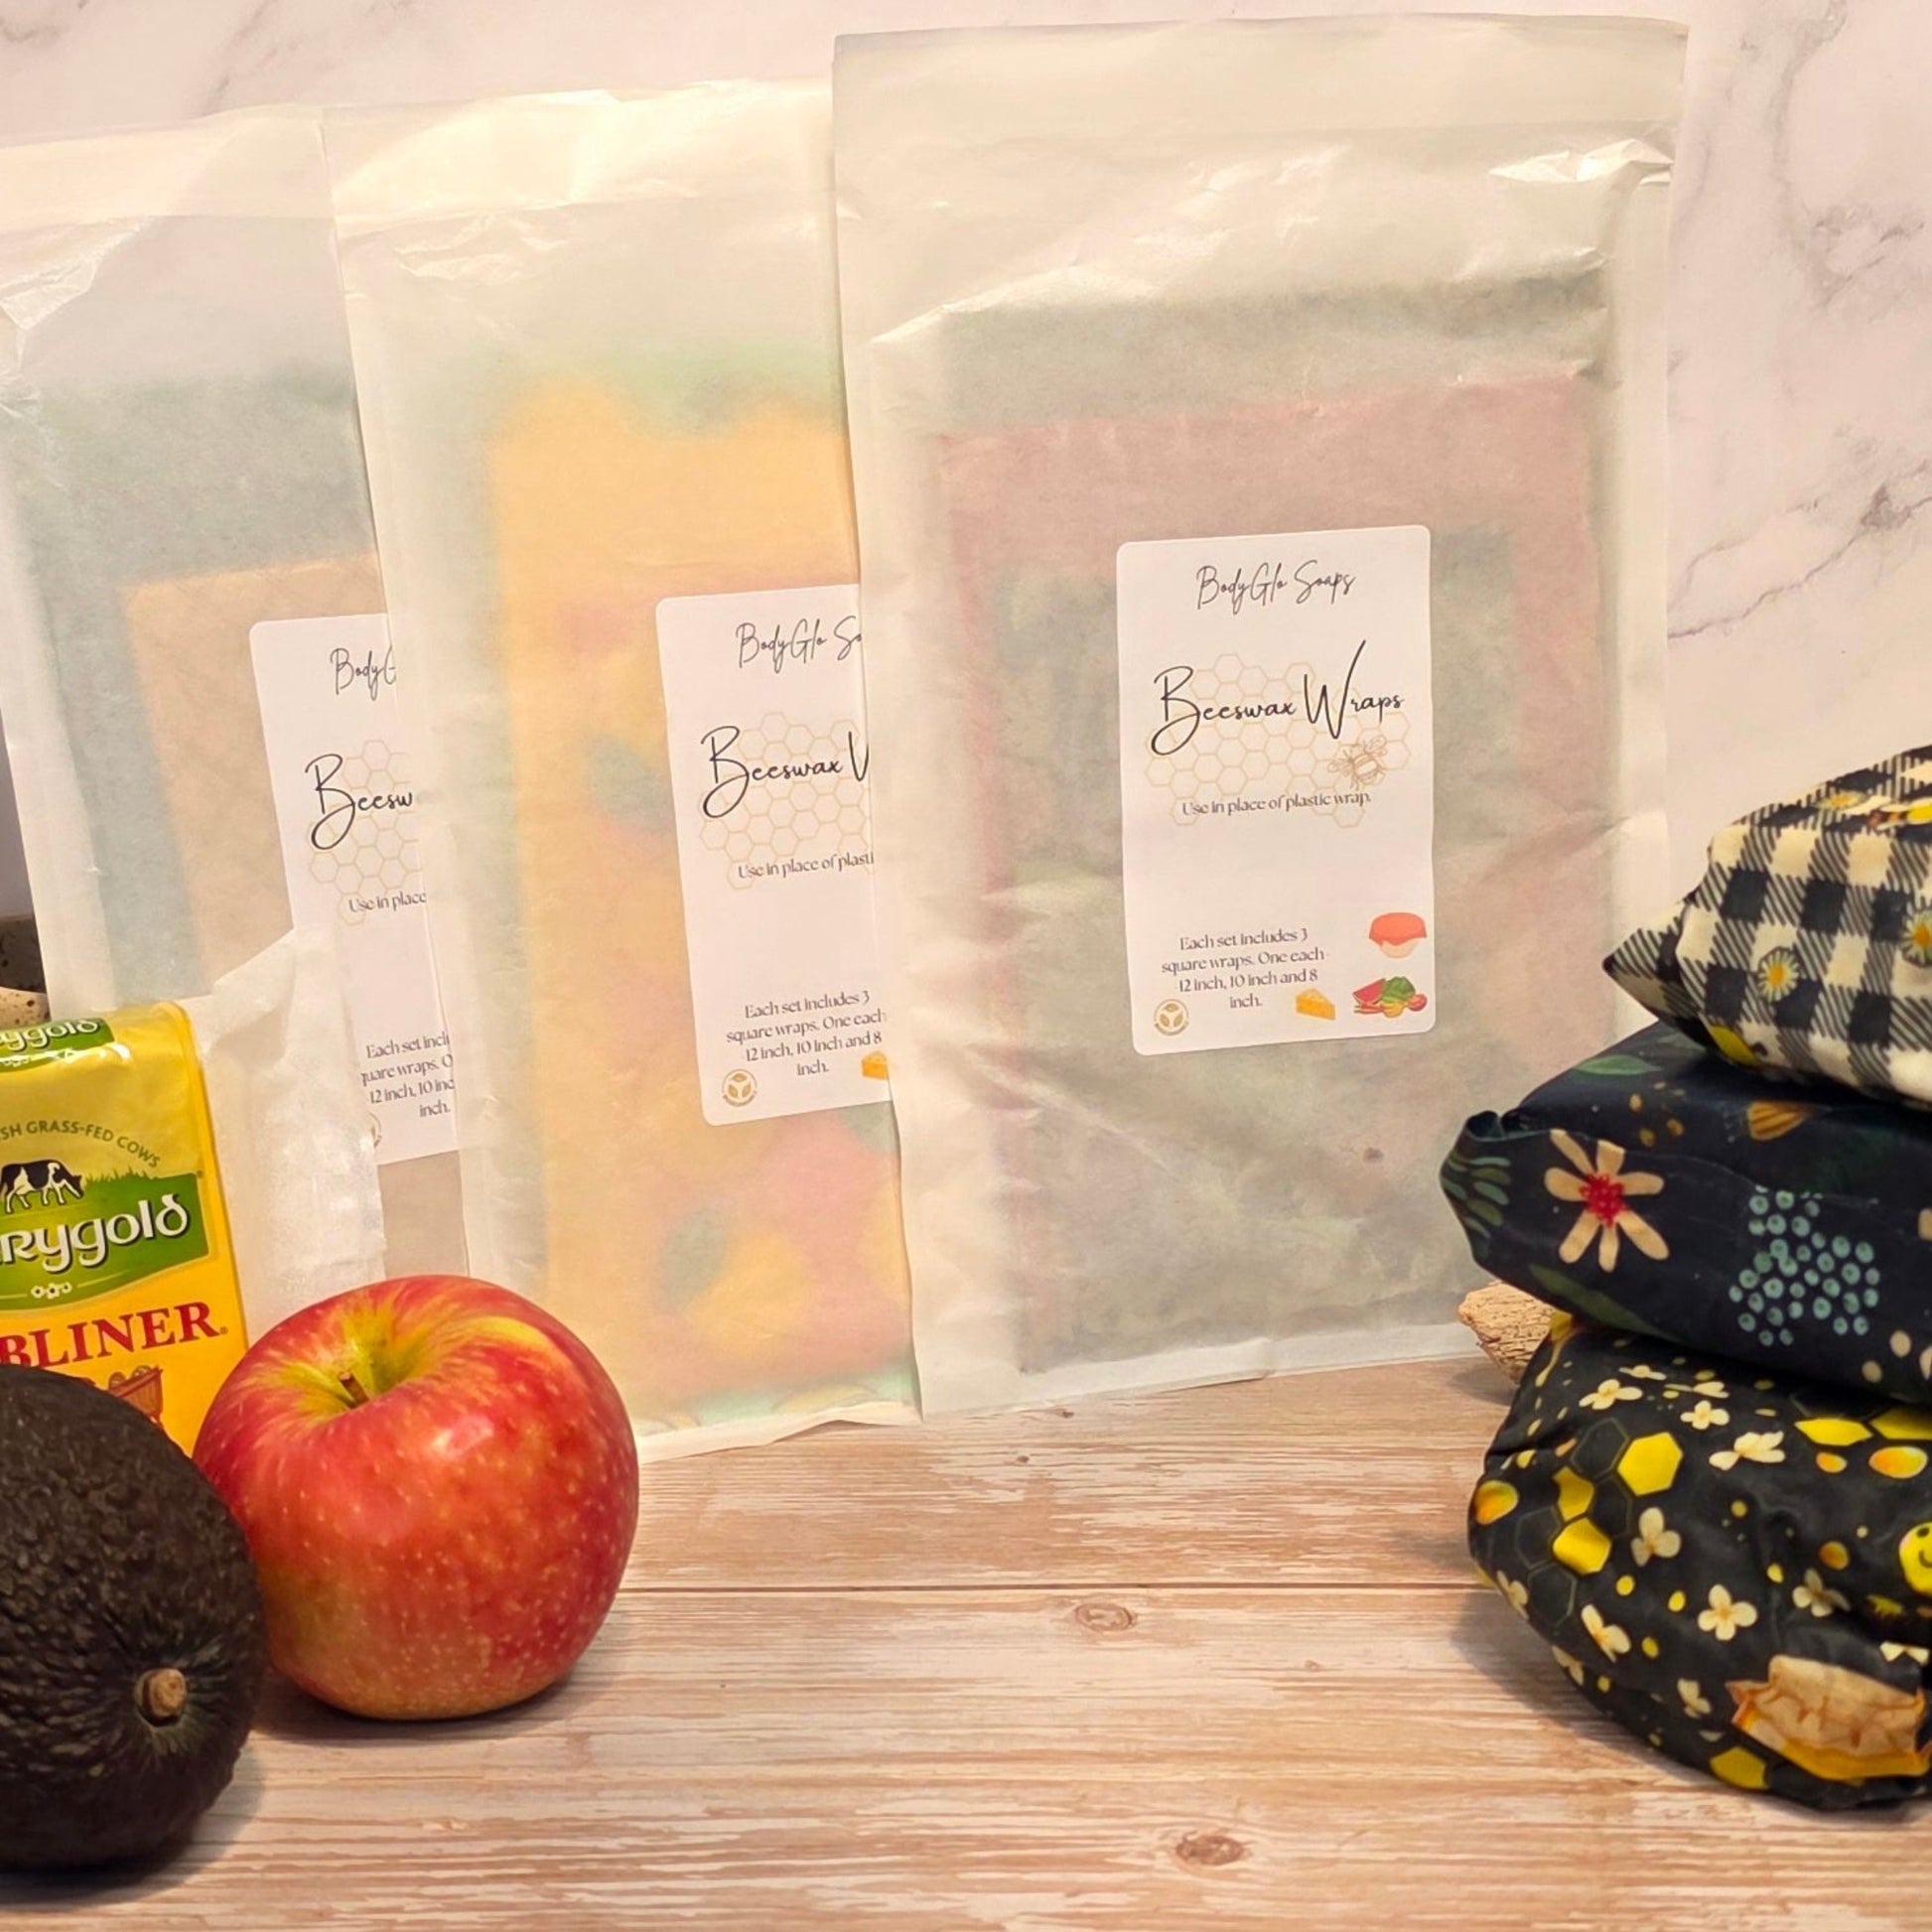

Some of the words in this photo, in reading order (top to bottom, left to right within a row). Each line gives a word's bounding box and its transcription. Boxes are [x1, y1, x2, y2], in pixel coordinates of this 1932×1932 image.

[1294, 559, 1356, 605] Soaps
[1151, 665, 1297, 756] Beeswax
[1304, 639, 1405, 740] Wraps
[701, 726, 843, 818] Beeswax
[1181, 802, 1208, 816] Use
[1211, 800, 1225, 814] in
[1228, 797, 1267, 816] place
[1268, 794, 1286, 809] of
[1286, 793, 1331, 812] plastic
[738, 864, 763, 879] Use
[766, 862, 779, 876] in
[782, 858, 819, 878] place
[821, 854, 838, 870] of
[348, 898, 374, 912] Use
[376, 896, 389, 908] in
[1179, 934, 1214, 951] Each
[1216, 936, 1238, 948] set
[1240, 928, 1298, 944] includes
[1301, 927, 1309, 942] 3
[1161, 958, 1208, 977] square
[1257, 951, 1289, 965] One
[1290, 946, 1325, 961] each
[1178, 979, 1191, 993] 12
[1193, 975, 1228, 991] inch,
[1229, 974, 1246, 989] 10
[1248, 971, 1278, 986] inch
[1279, 969, 1307, 983] and
[1309, 969, 1318, 982] 8
[745, 1001, 779, 1019] Each
[781, 1001, 801, 1013] set
[804, 992, 860, 1011] includes
[862, 990, 870, 1006] 3
[1229, 993, 1263, 1009] inch.
[726, 1028, 773, 1045] square
[822, 1016, 851, 1030] One
[366, 1038, 399, 1058] Each
[401, 1037, 420, 1052] set
[746, 1047, 759, 1061] 12
[796, 1040, 810, 1054] 10
[814, 1035, 843, 1052] inch
[845, 1030, 871, 1047] and
[873, 1031, 883, 1045] 8
[369, 1088, 382, 1104] 12
[418, 1080, 433, 1095] 10
[26, 1120, 114, 1143] GRASS-FED
[116, 1135, 161, 1169] COWS
